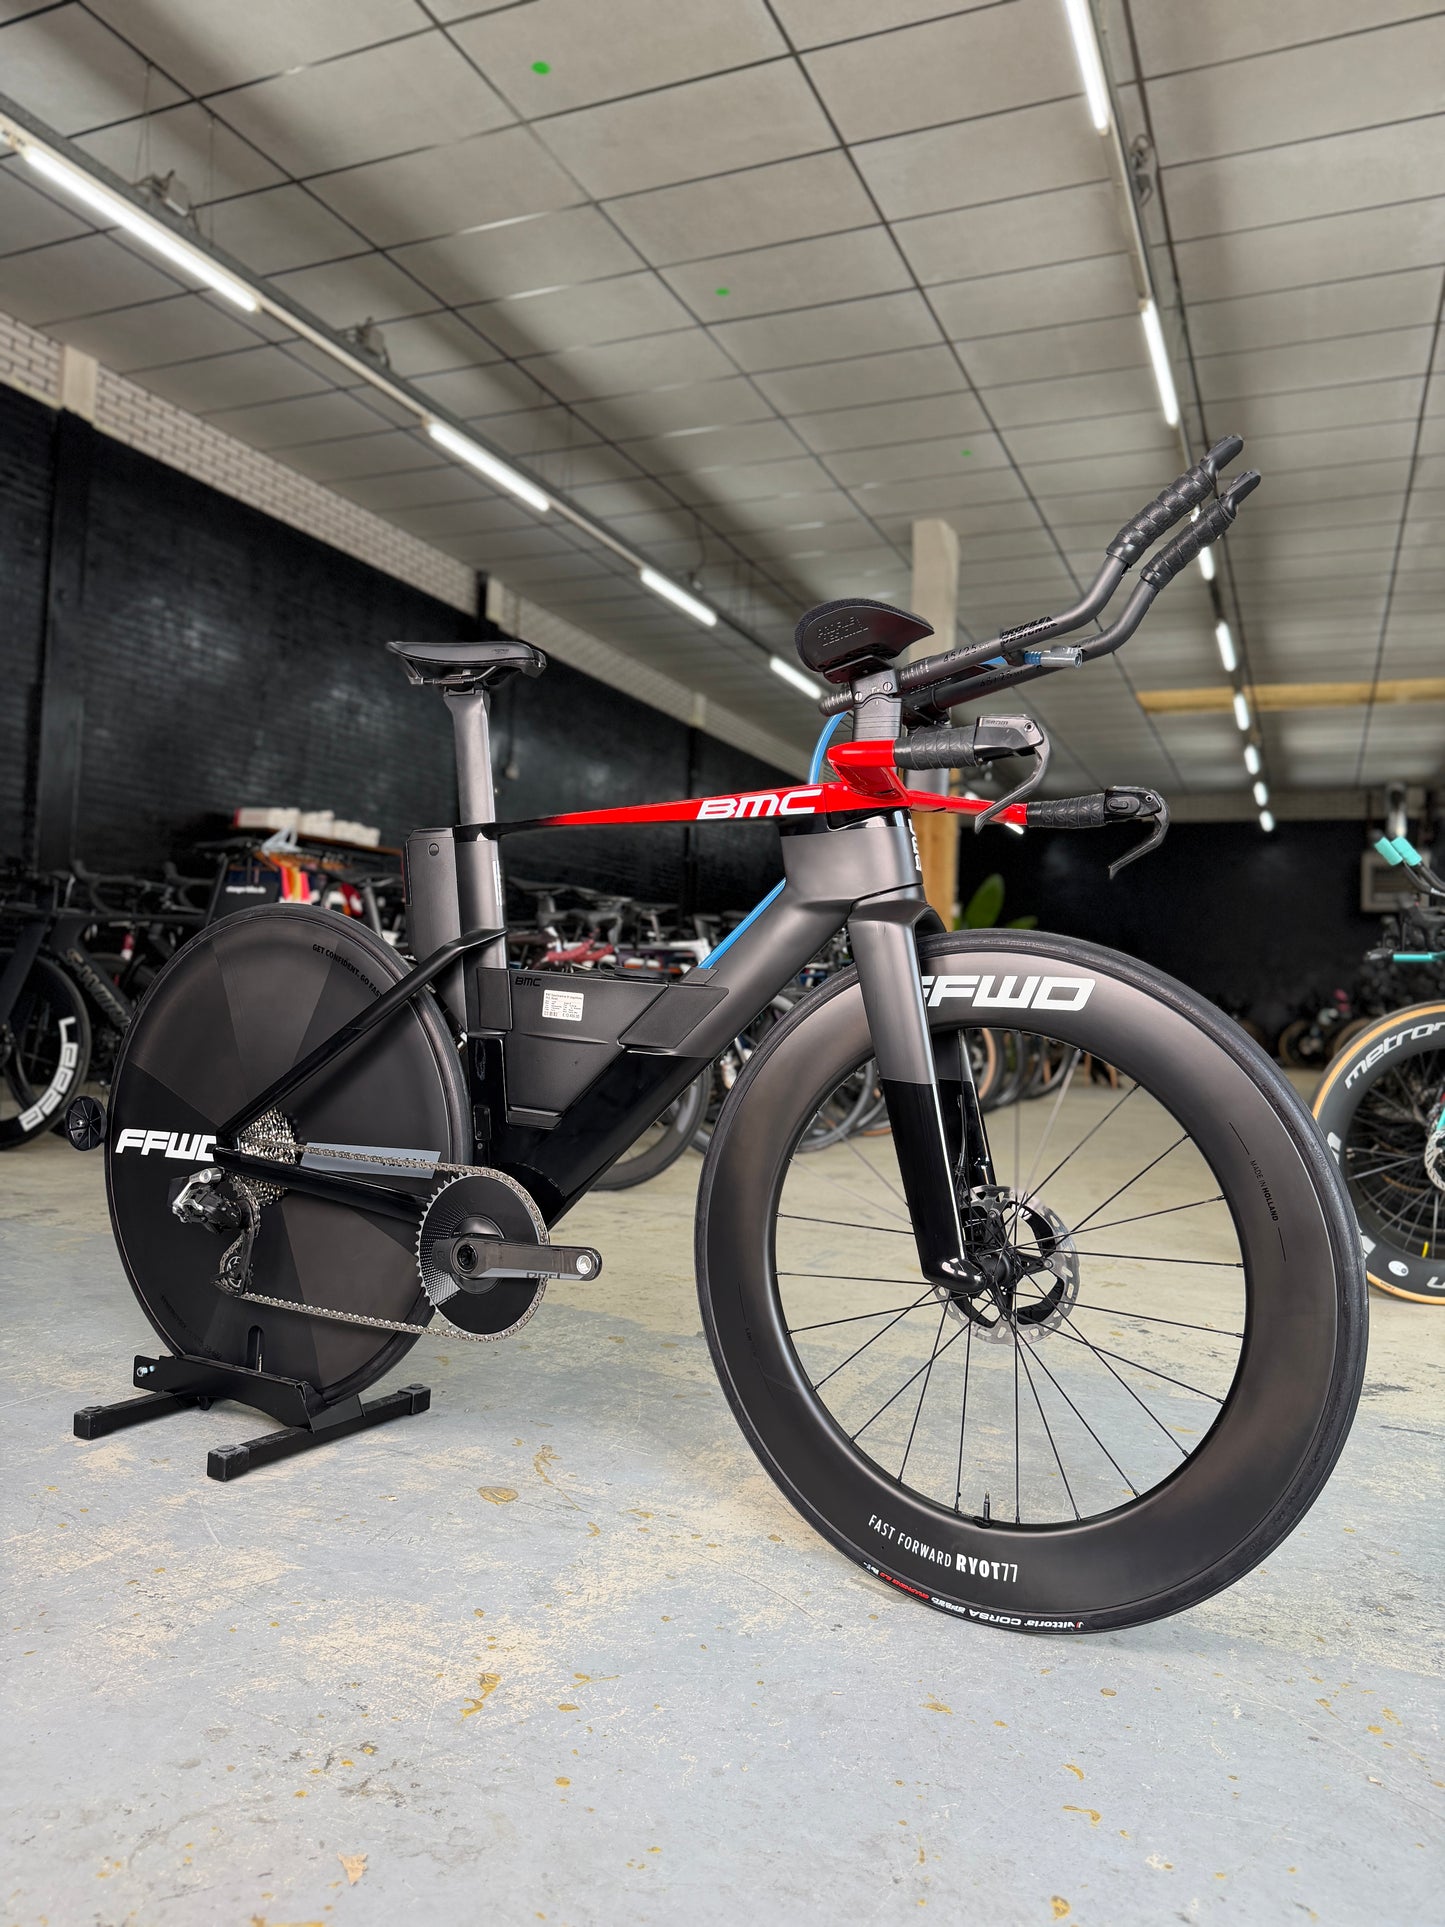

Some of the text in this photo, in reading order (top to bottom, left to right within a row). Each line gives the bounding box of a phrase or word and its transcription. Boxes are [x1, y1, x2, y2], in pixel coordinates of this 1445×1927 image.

[696, 789, 822, 819] BMC
[312, 944, 325, 954] GET
[360, 974, 370, 985] GO
[515, 976, 542, 987] BMC
[1262, 1187, 1279, 1221] HOLLAND
[868, 1514, 896, 1540] FAST
[897, 1532, 952, 1568] FORWARD
[969, 1609, 1022, 1626] CORSA
